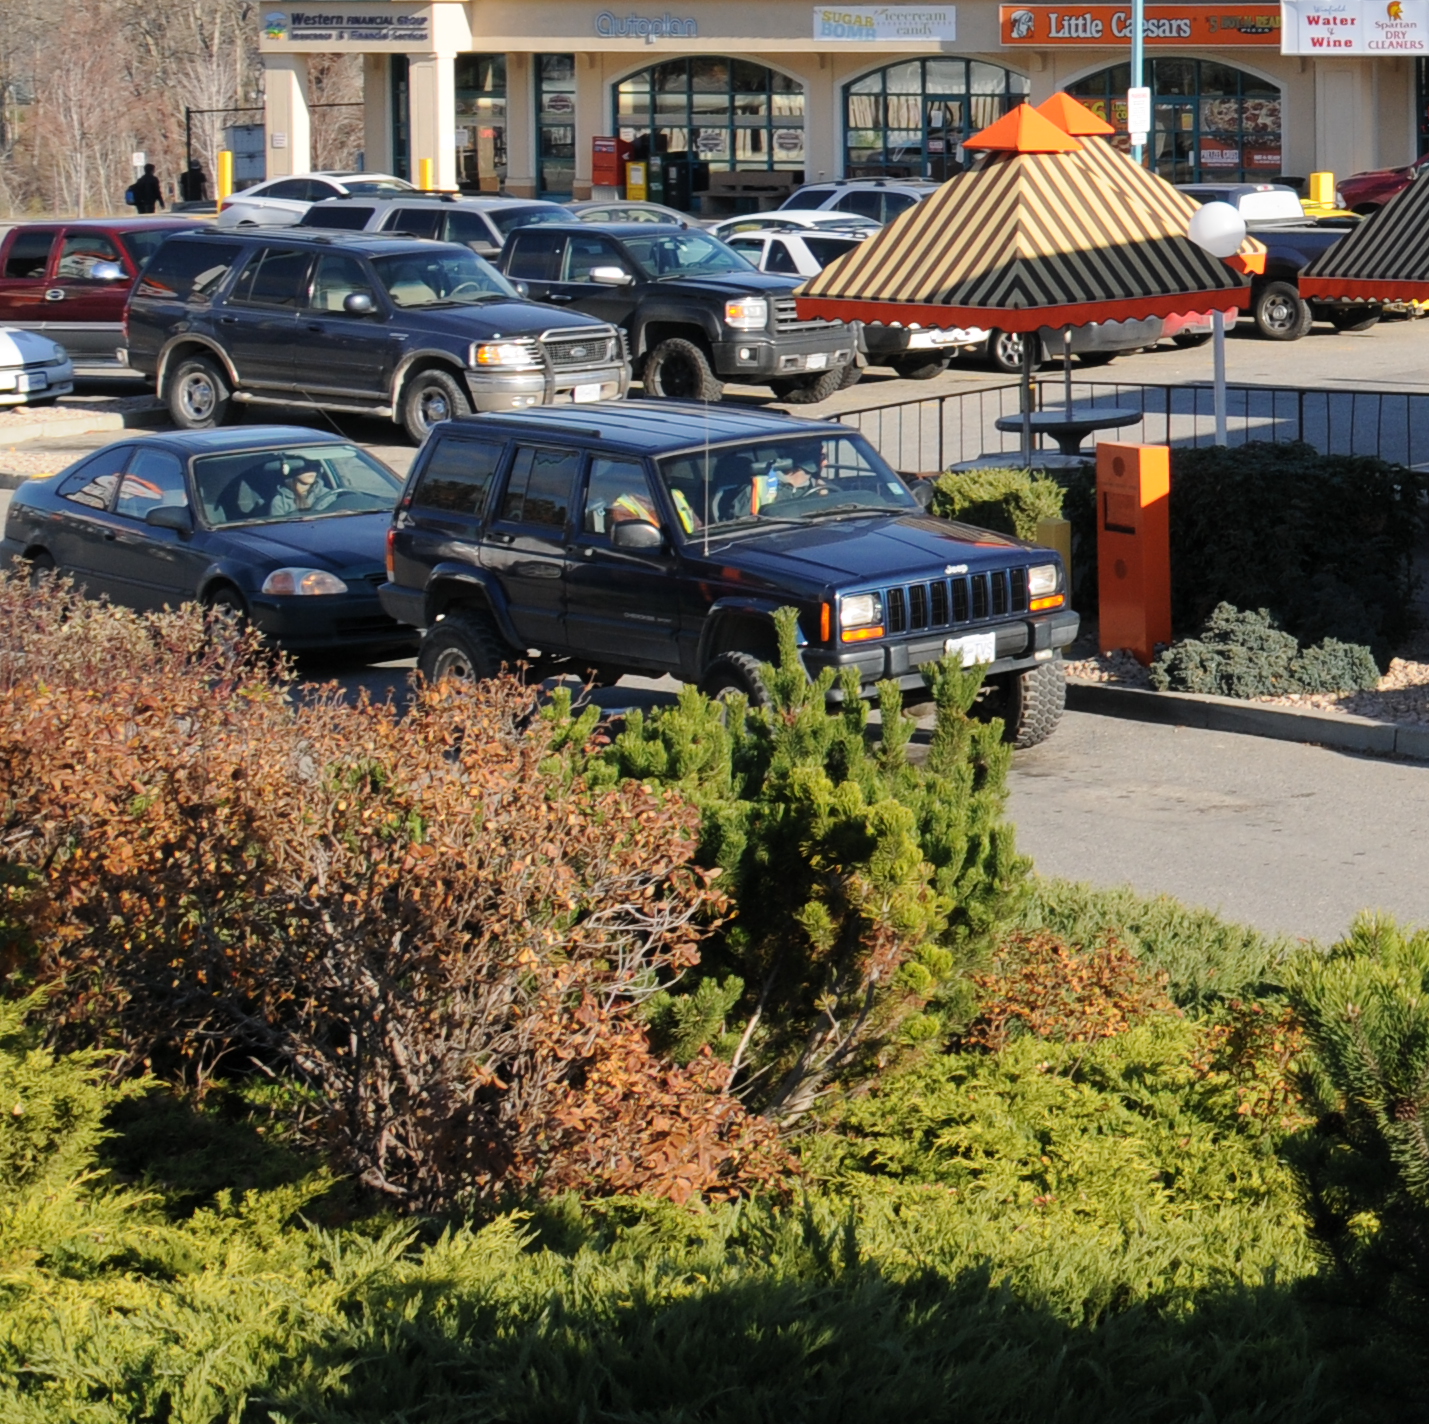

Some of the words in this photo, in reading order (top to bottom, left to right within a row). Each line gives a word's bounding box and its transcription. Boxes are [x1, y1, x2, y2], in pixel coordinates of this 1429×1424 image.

[291, 13, 343, 25] Western
[822, 10, 875, 27] SUGAR
[1306, 15, 1356, 26] Water
[595, 11, 697, 42] Autoplan
[896, 24, 932, 38] candy
[1048, 12, 1103, 38] Little
[1374, 20, 1417, 30] Spartan
[821, 22, 876, 41] BOMB
[1385, 31, 1407, 40] DRY
[1310, 37, 1353, 48] Wine
[1368, 40, 1424, 50] CLEANERS
